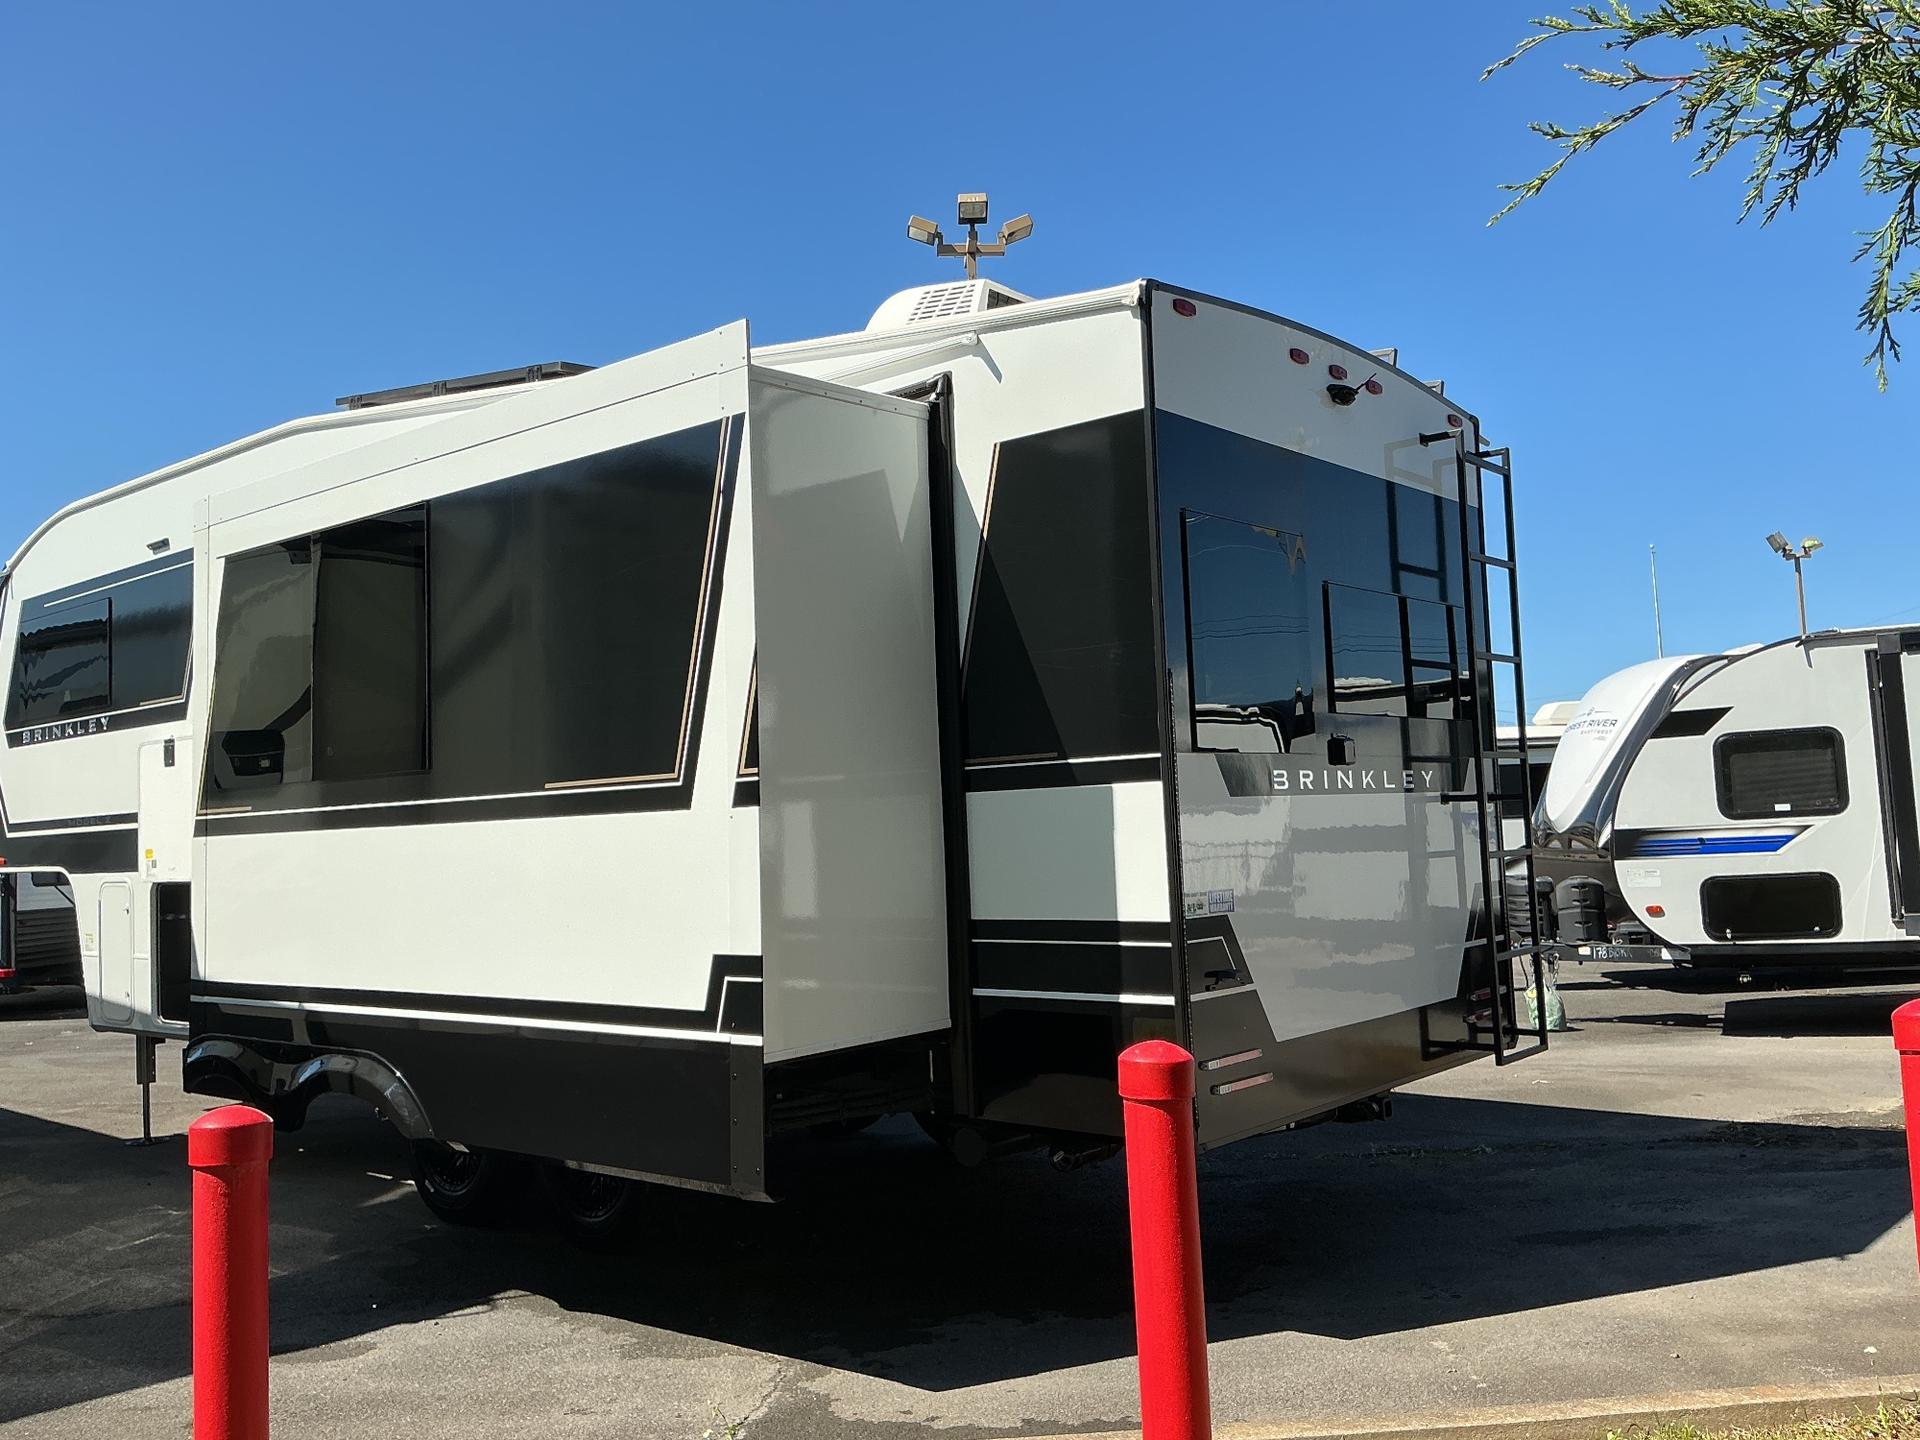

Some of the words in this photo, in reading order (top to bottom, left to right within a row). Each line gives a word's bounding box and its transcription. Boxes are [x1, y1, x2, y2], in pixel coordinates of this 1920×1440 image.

[22, 716, 109, 744] BRINKLEY
[1587, 719, 1618, 728] RIVER
[1273, 769, 1433, 790] BRINKLEY
